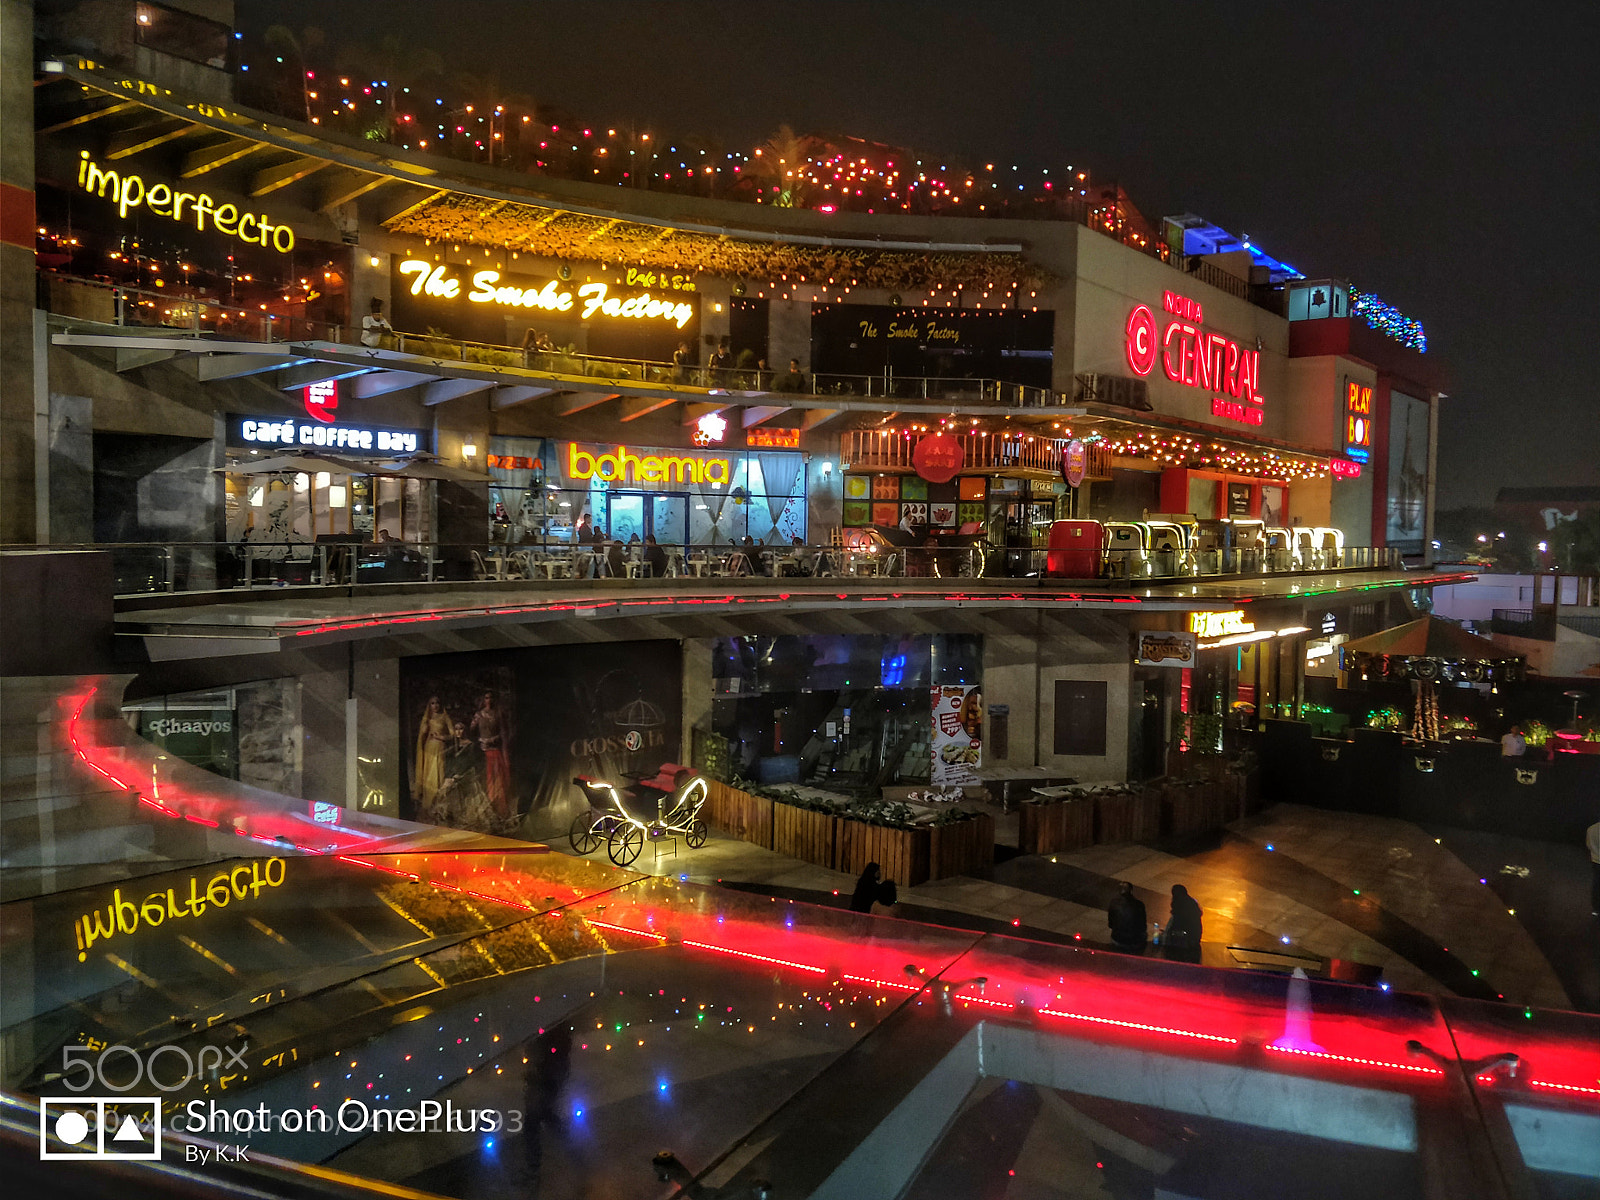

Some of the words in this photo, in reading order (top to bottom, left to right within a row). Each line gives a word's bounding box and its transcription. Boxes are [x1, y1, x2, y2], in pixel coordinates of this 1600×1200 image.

[78, 150, 295, 253] imperfecto
[399, 259, 461, 299] The
[468, 270, 574, 312] Smoke
[577, 282, 693, 329] Factory
[626, 267, 657, 288] Cafe
[671, 274, 697, 292] Bar
[1164, 289, 1203, 323] NOIDA
[859, 320, 878, 338] The
[887, 322, 919, 338] Smoke
[926, 321, 960, 343] Factory
[1163, 321, 1264, 404] CENTRAL
[1348, 382, 1373, 415] PLAY
[1347, 415, 1370, 447] BOX
[487, 454, 543, 470] PIZZERIA
[568, 442, 729, 485] bohemia
[149, 718, 232, 737] Chaayos
